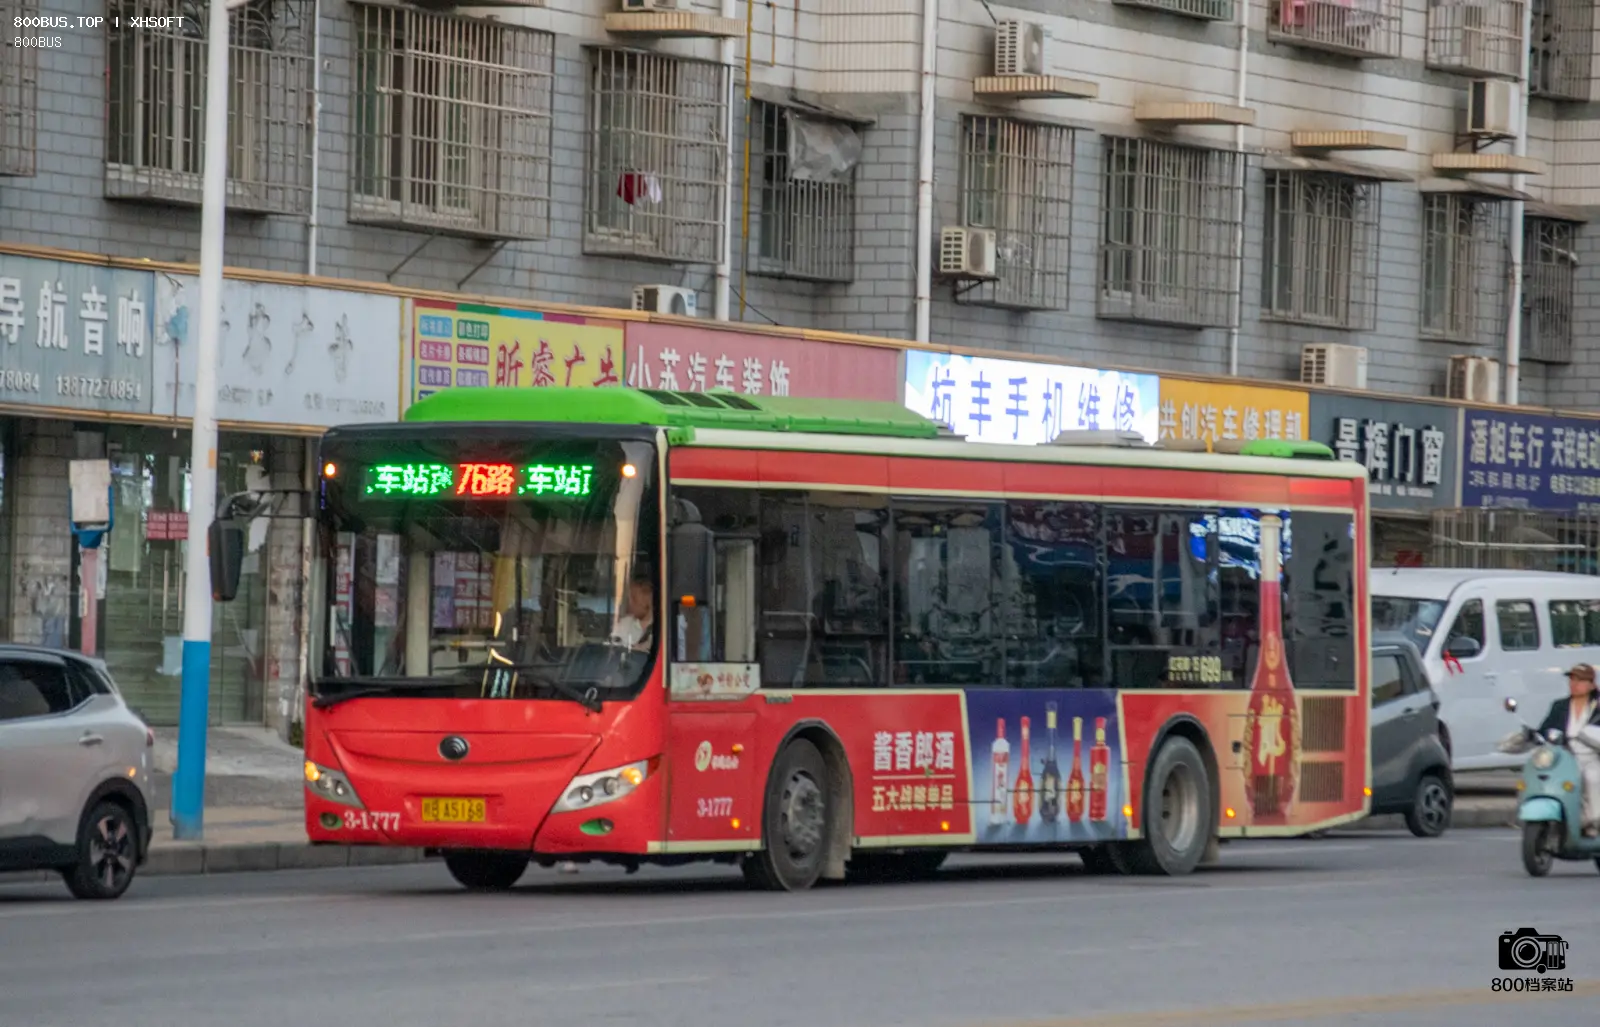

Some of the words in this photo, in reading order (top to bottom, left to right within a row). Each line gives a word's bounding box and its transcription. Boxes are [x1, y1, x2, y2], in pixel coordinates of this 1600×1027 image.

[627, 344, 791, 398] 小苏汽车装饰
[930, 365, 1136, 443] 杭丰手机维修
[456, 463, 514, 495] 76路
[873, 731, 955, 771] 酱香郎酒
[344, 809, 401, 832] 3-1777
